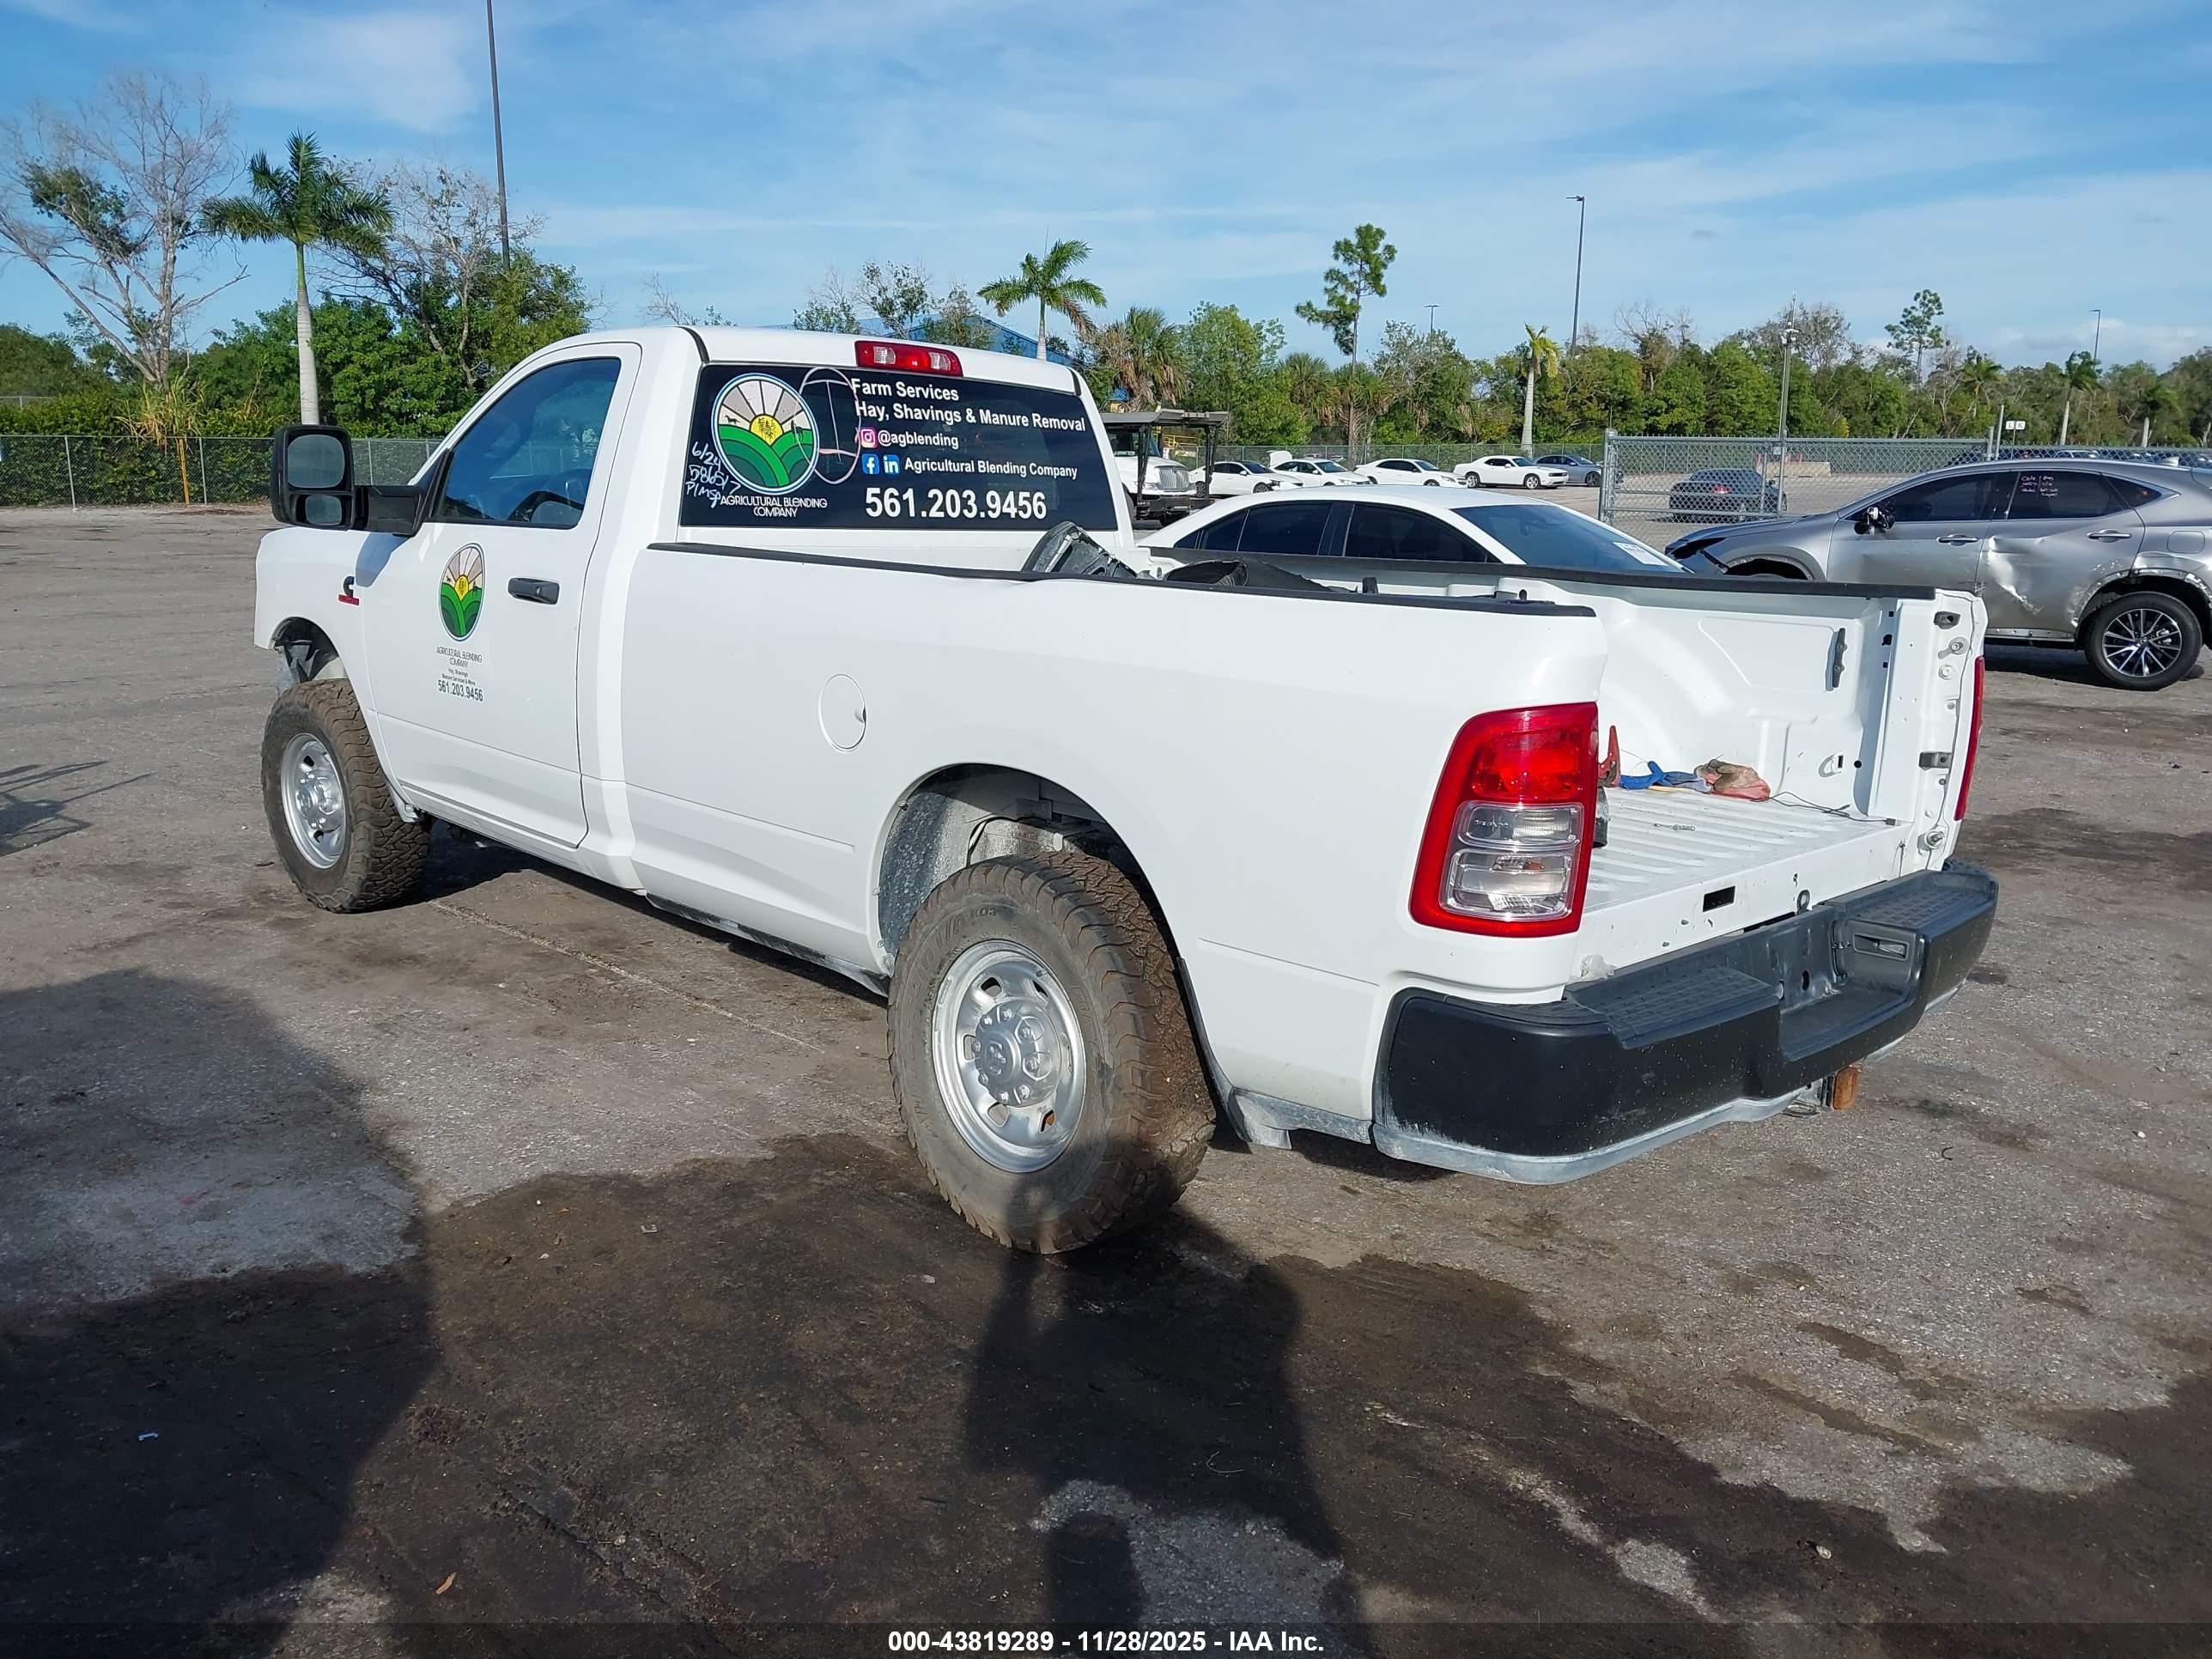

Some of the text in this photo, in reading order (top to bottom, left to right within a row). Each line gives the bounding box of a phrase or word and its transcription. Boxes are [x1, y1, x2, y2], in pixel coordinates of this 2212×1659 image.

[851, 378, 959, 401] Farm Services
[854, 400, 1086, 432] Hay, Shavings & Manure Removal
[878, 429, 959, 450] @agblending
[691, 441, 721, 471] 6/24
[904, 457, 975, 474] Agricultural
[977, 459, 1027, 478] Blending
[1030, 462, 1078, 480] Company
[720, 495, 828, 508] AGRICULTURAL BLENDING
[753, 507, 798, 518] COMPANY
[865, 487, 1047, 520] 561.203.9456
[437, 679, 483, 702] 561.203.9456
